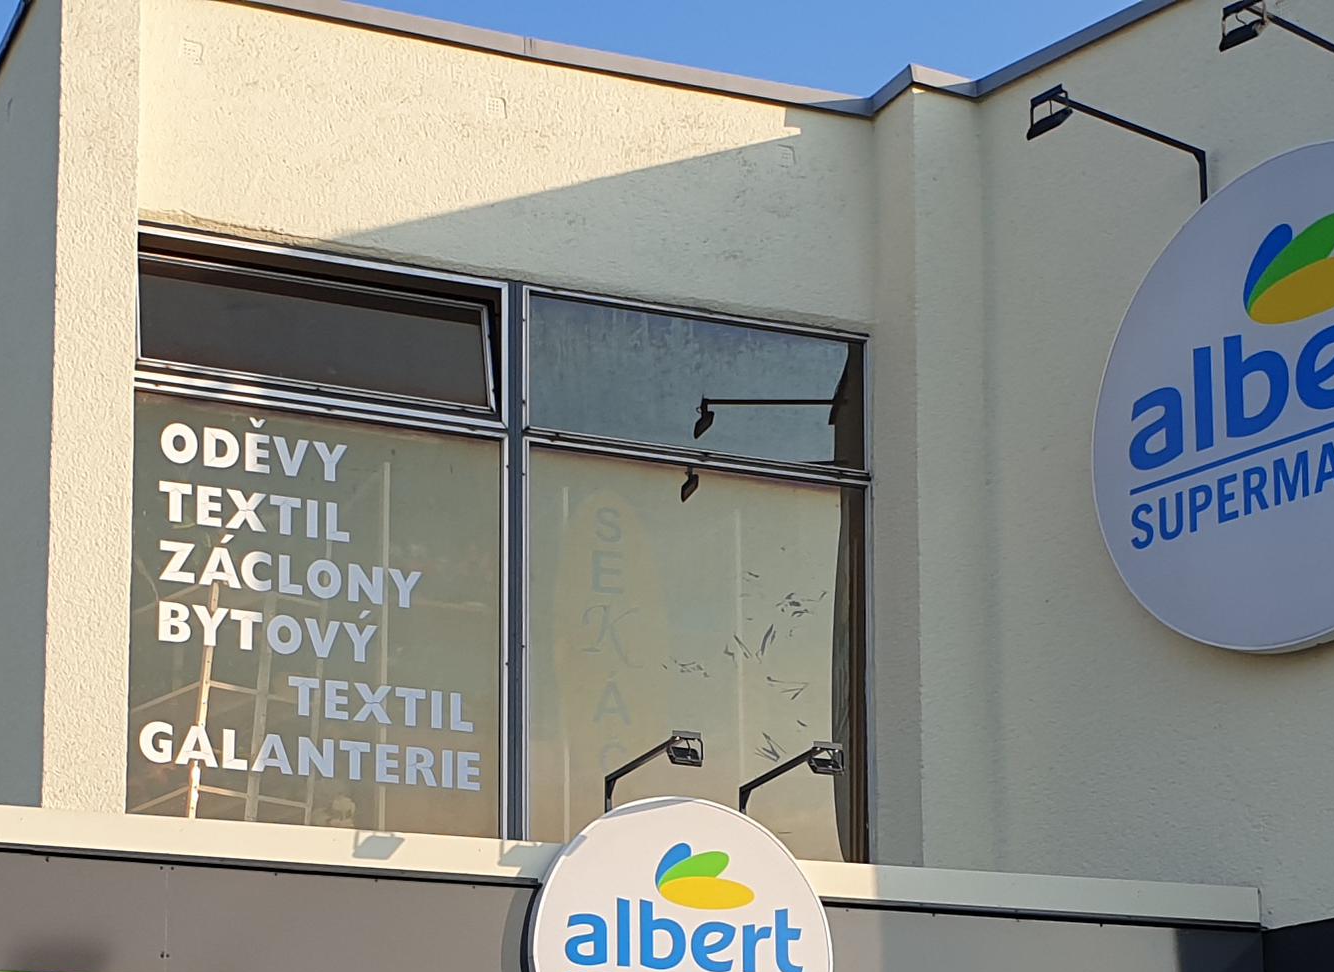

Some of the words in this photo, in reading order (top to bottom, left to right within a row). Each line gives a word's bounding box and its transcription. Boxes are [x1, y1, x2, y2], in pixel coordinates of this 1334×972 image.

[159, 416, 348, 483] ODĚVY
[158, 480, 351, 543] TEXTIL
[158, 534, 423, 609] ZÁCLONY
[157, 601, 378, 663] BYTOVÝ
[287, 675, 476, 734] TEXTIL
[138, 721, 482, 792] GALANTERIE
